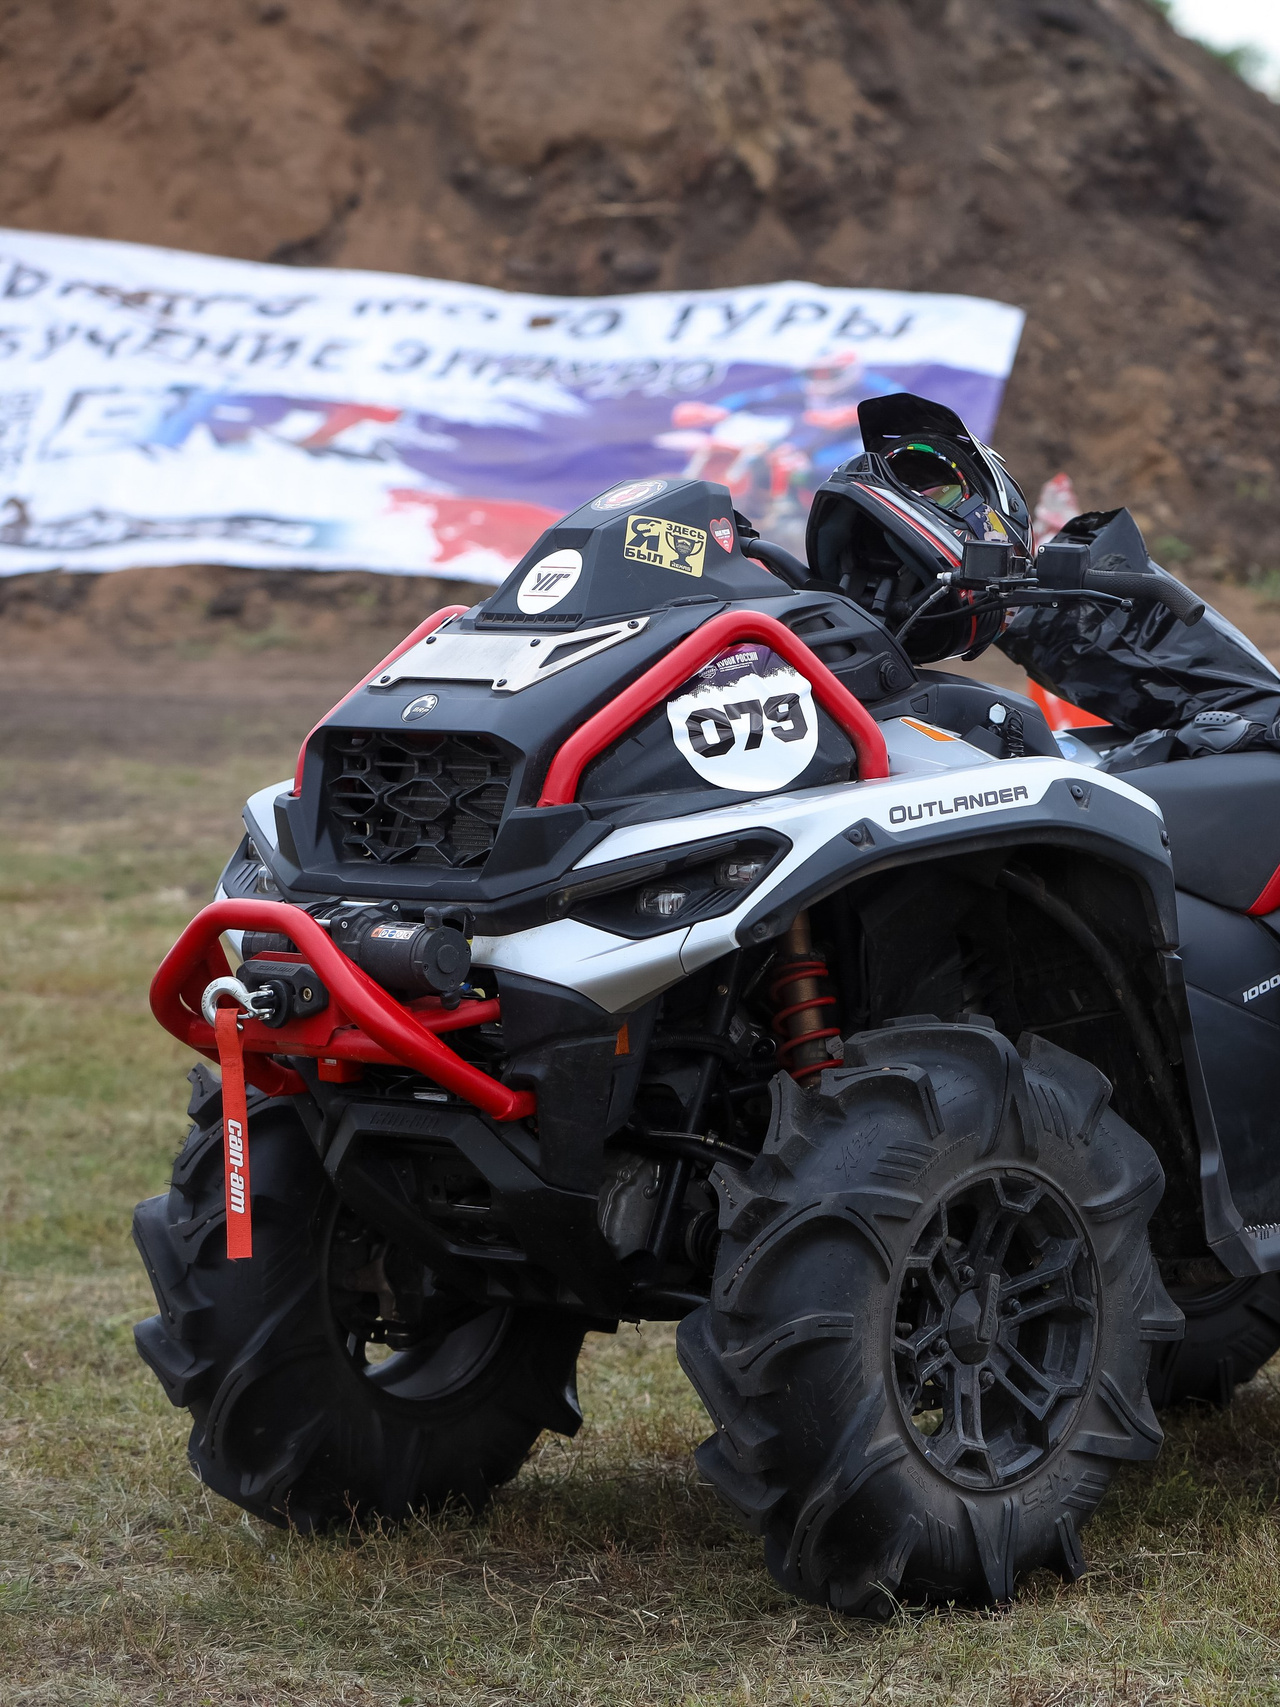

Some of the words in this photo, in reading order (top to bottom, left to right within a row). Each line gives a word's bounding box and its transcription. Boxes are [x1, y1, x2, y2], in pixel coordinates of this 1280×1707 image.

[666, 523, 705, 540] ЗДЕСЬ
[625, 547, 664, 565] БЫЛ
[685, 692, 809, 758] 079
[889, 785, 1029, 824] OUTLANDER
[227, 1118, 246, 1214] can-am
